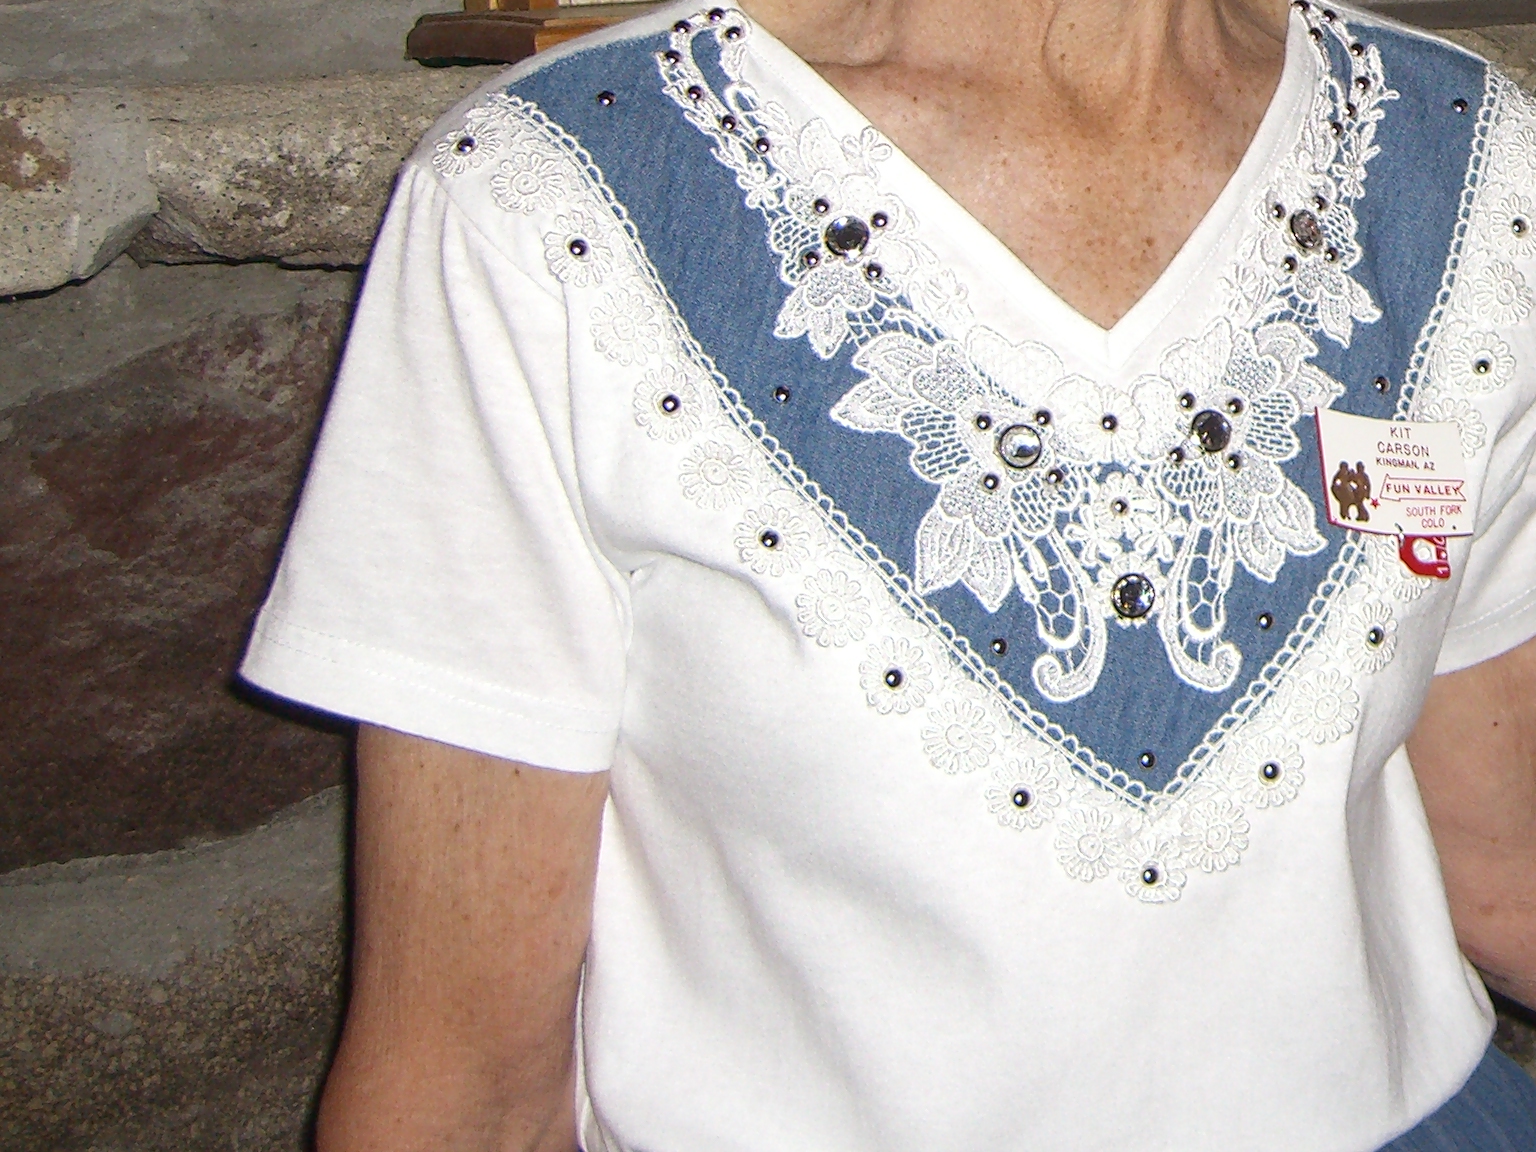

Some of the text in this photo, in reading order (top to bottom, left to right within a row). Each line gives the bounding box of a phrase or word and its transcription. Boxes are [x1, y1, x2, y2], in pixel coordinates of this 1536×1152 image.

[1390, 427, 1411, 439] KIT
[1377, 441, 1430, 457] CARSON
[1423, 461, 1436, 471] AZ
[1386, 483, 1459, 496] FUN VALLEY
[1406, 504, 1462, 517] SOUTH FORK
[1421, 518, 1445, 528] COLO
